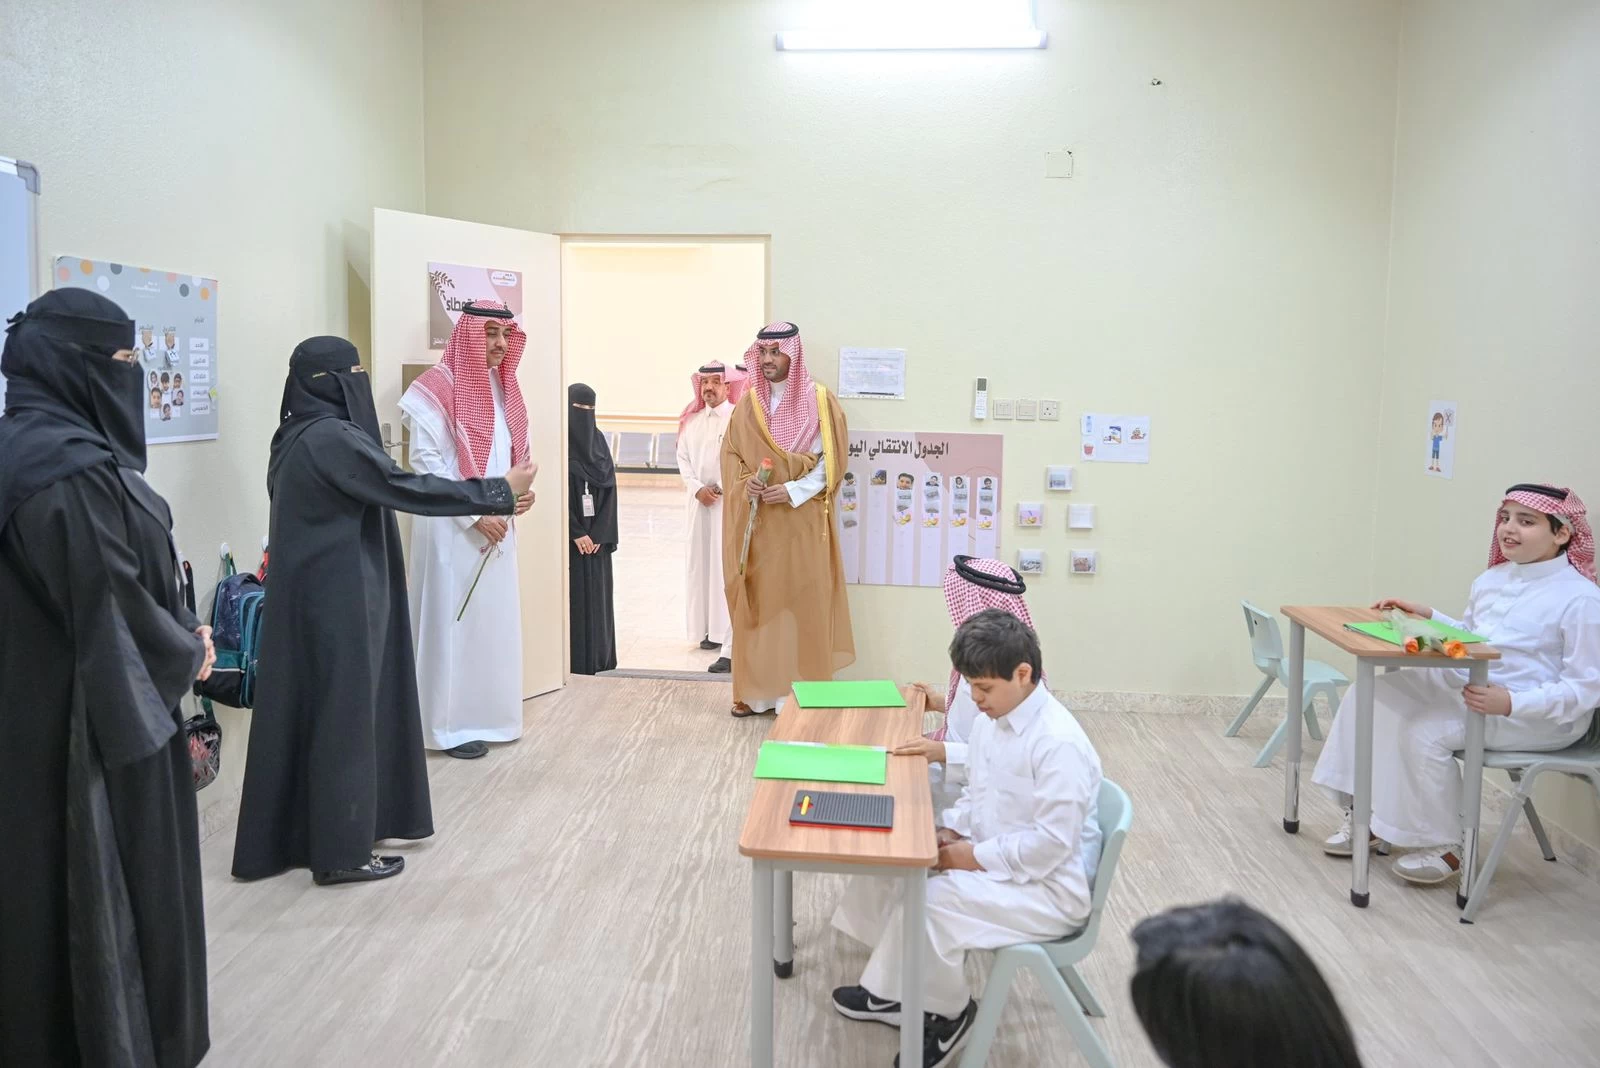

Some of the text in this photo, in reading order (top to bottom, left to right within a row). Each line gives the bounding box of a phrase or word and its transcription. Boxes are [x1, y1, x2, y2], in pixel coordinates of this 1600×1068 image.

[848, 438, 949, 460] الجدول الانتقالي اليو
